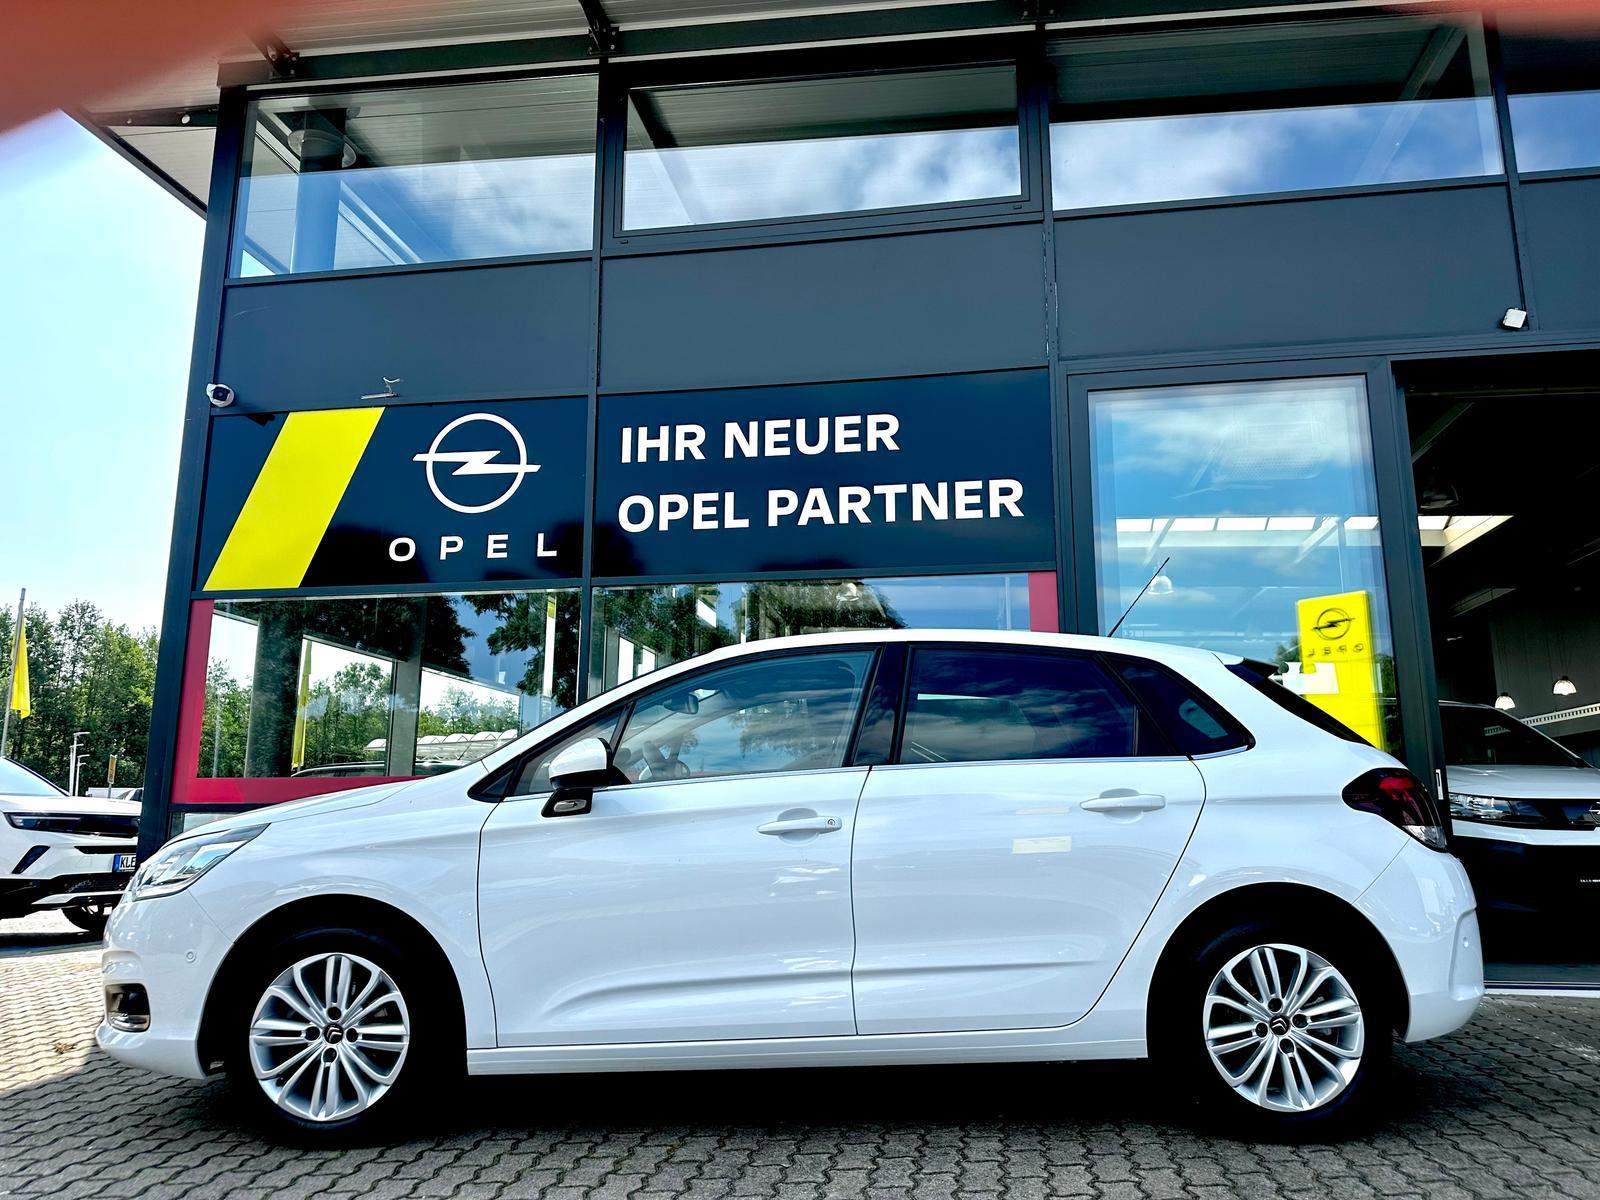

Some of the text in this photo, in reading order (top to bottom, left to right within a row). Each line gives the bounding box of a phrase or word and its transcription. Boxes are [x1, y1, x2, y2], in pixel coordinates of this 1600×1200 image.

[621, 413, 900, 465] IHR NEUER
[618, 478, 1025, 533] OPEL PARTNER
[388, 532, 558, 562] OPEL
